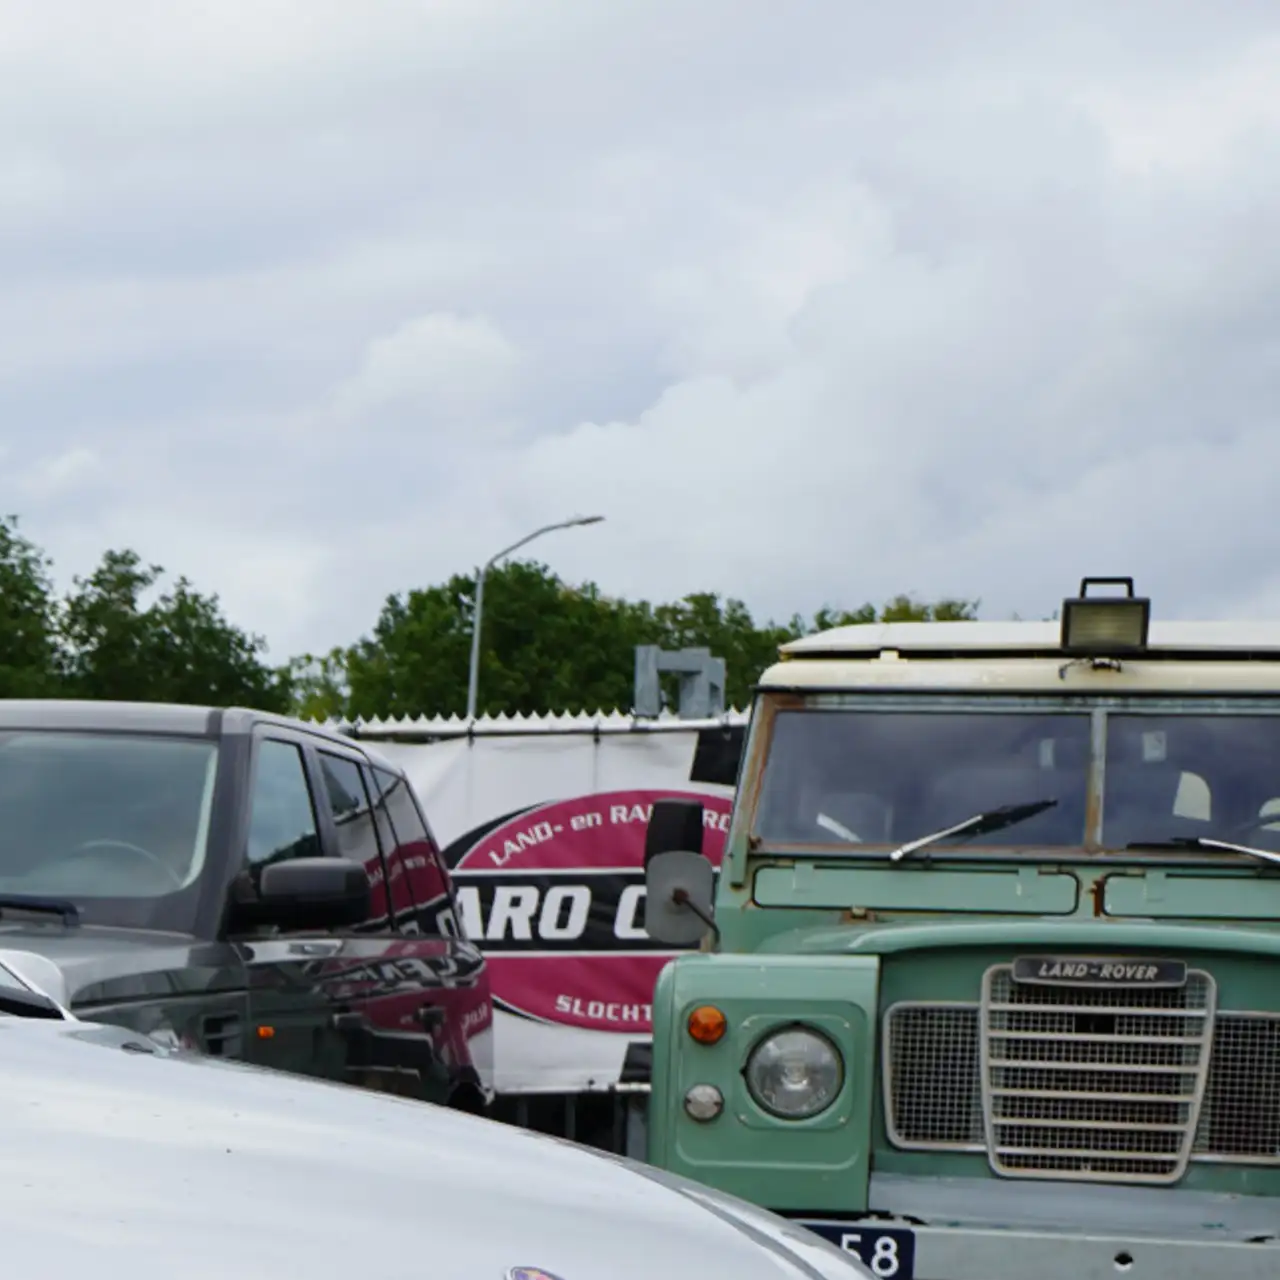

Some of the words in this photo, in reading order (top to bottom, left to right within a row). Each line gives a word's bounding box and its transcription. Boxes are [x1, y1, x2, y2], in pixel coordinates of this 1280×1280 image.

[488, 821, 564, 866] LAND-
[570, 811, 603, 832] en
[1038, 961, 1159, 981] LAND-ROVER
[841, 1232, 900, 1278] 58
